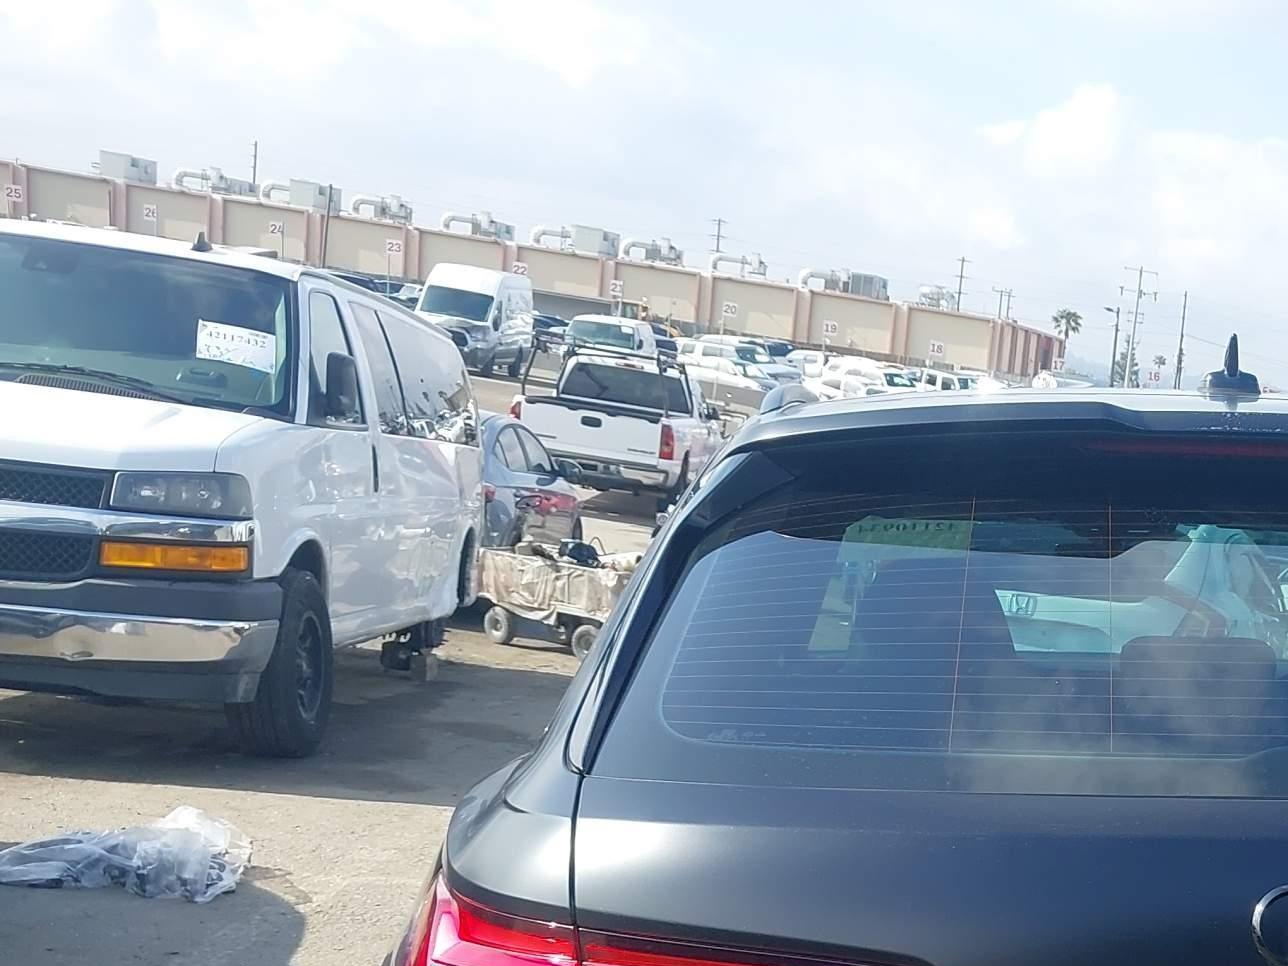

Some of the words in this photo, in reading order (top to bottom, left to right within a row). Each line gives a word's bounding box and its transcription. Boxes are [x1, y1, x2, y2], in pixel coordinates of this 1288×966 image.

[5, 186, 22, 199] 25
[387, 241, 401, 253] 23
[513, 264, 528, 276] 22
[723, 303, 737, 315] 20
[824, 323, 837, 334] 19
[930, 343, 943, 354] 18
